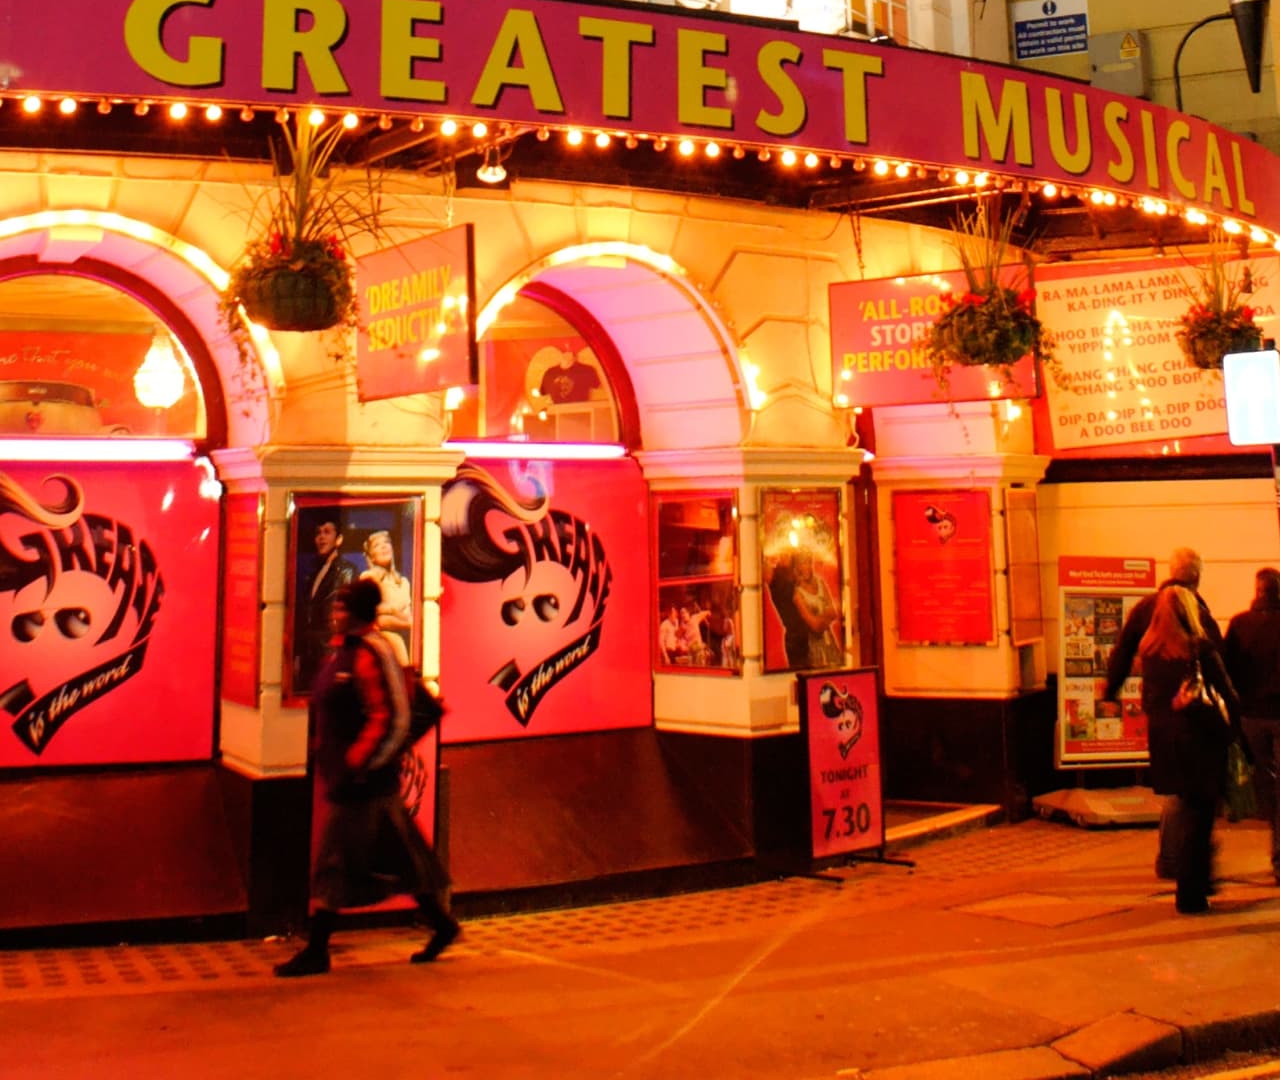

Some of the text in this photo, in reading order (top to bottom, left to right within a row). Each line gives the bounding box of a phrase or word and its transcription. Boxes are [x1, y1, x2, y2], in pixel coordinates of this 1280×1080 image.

[960, 69, 1257, 218] MUSICAL
[1080, 416, 1192, 439] A DOO BEE DOO
[482, 506, 614, 628] GREASE
[531, 663, 556, 698] the
[28, 653, 134, 748] is the word
[820, 763, 870, 784] TONIGHT
[822, 802, 871, 841] 7.30
